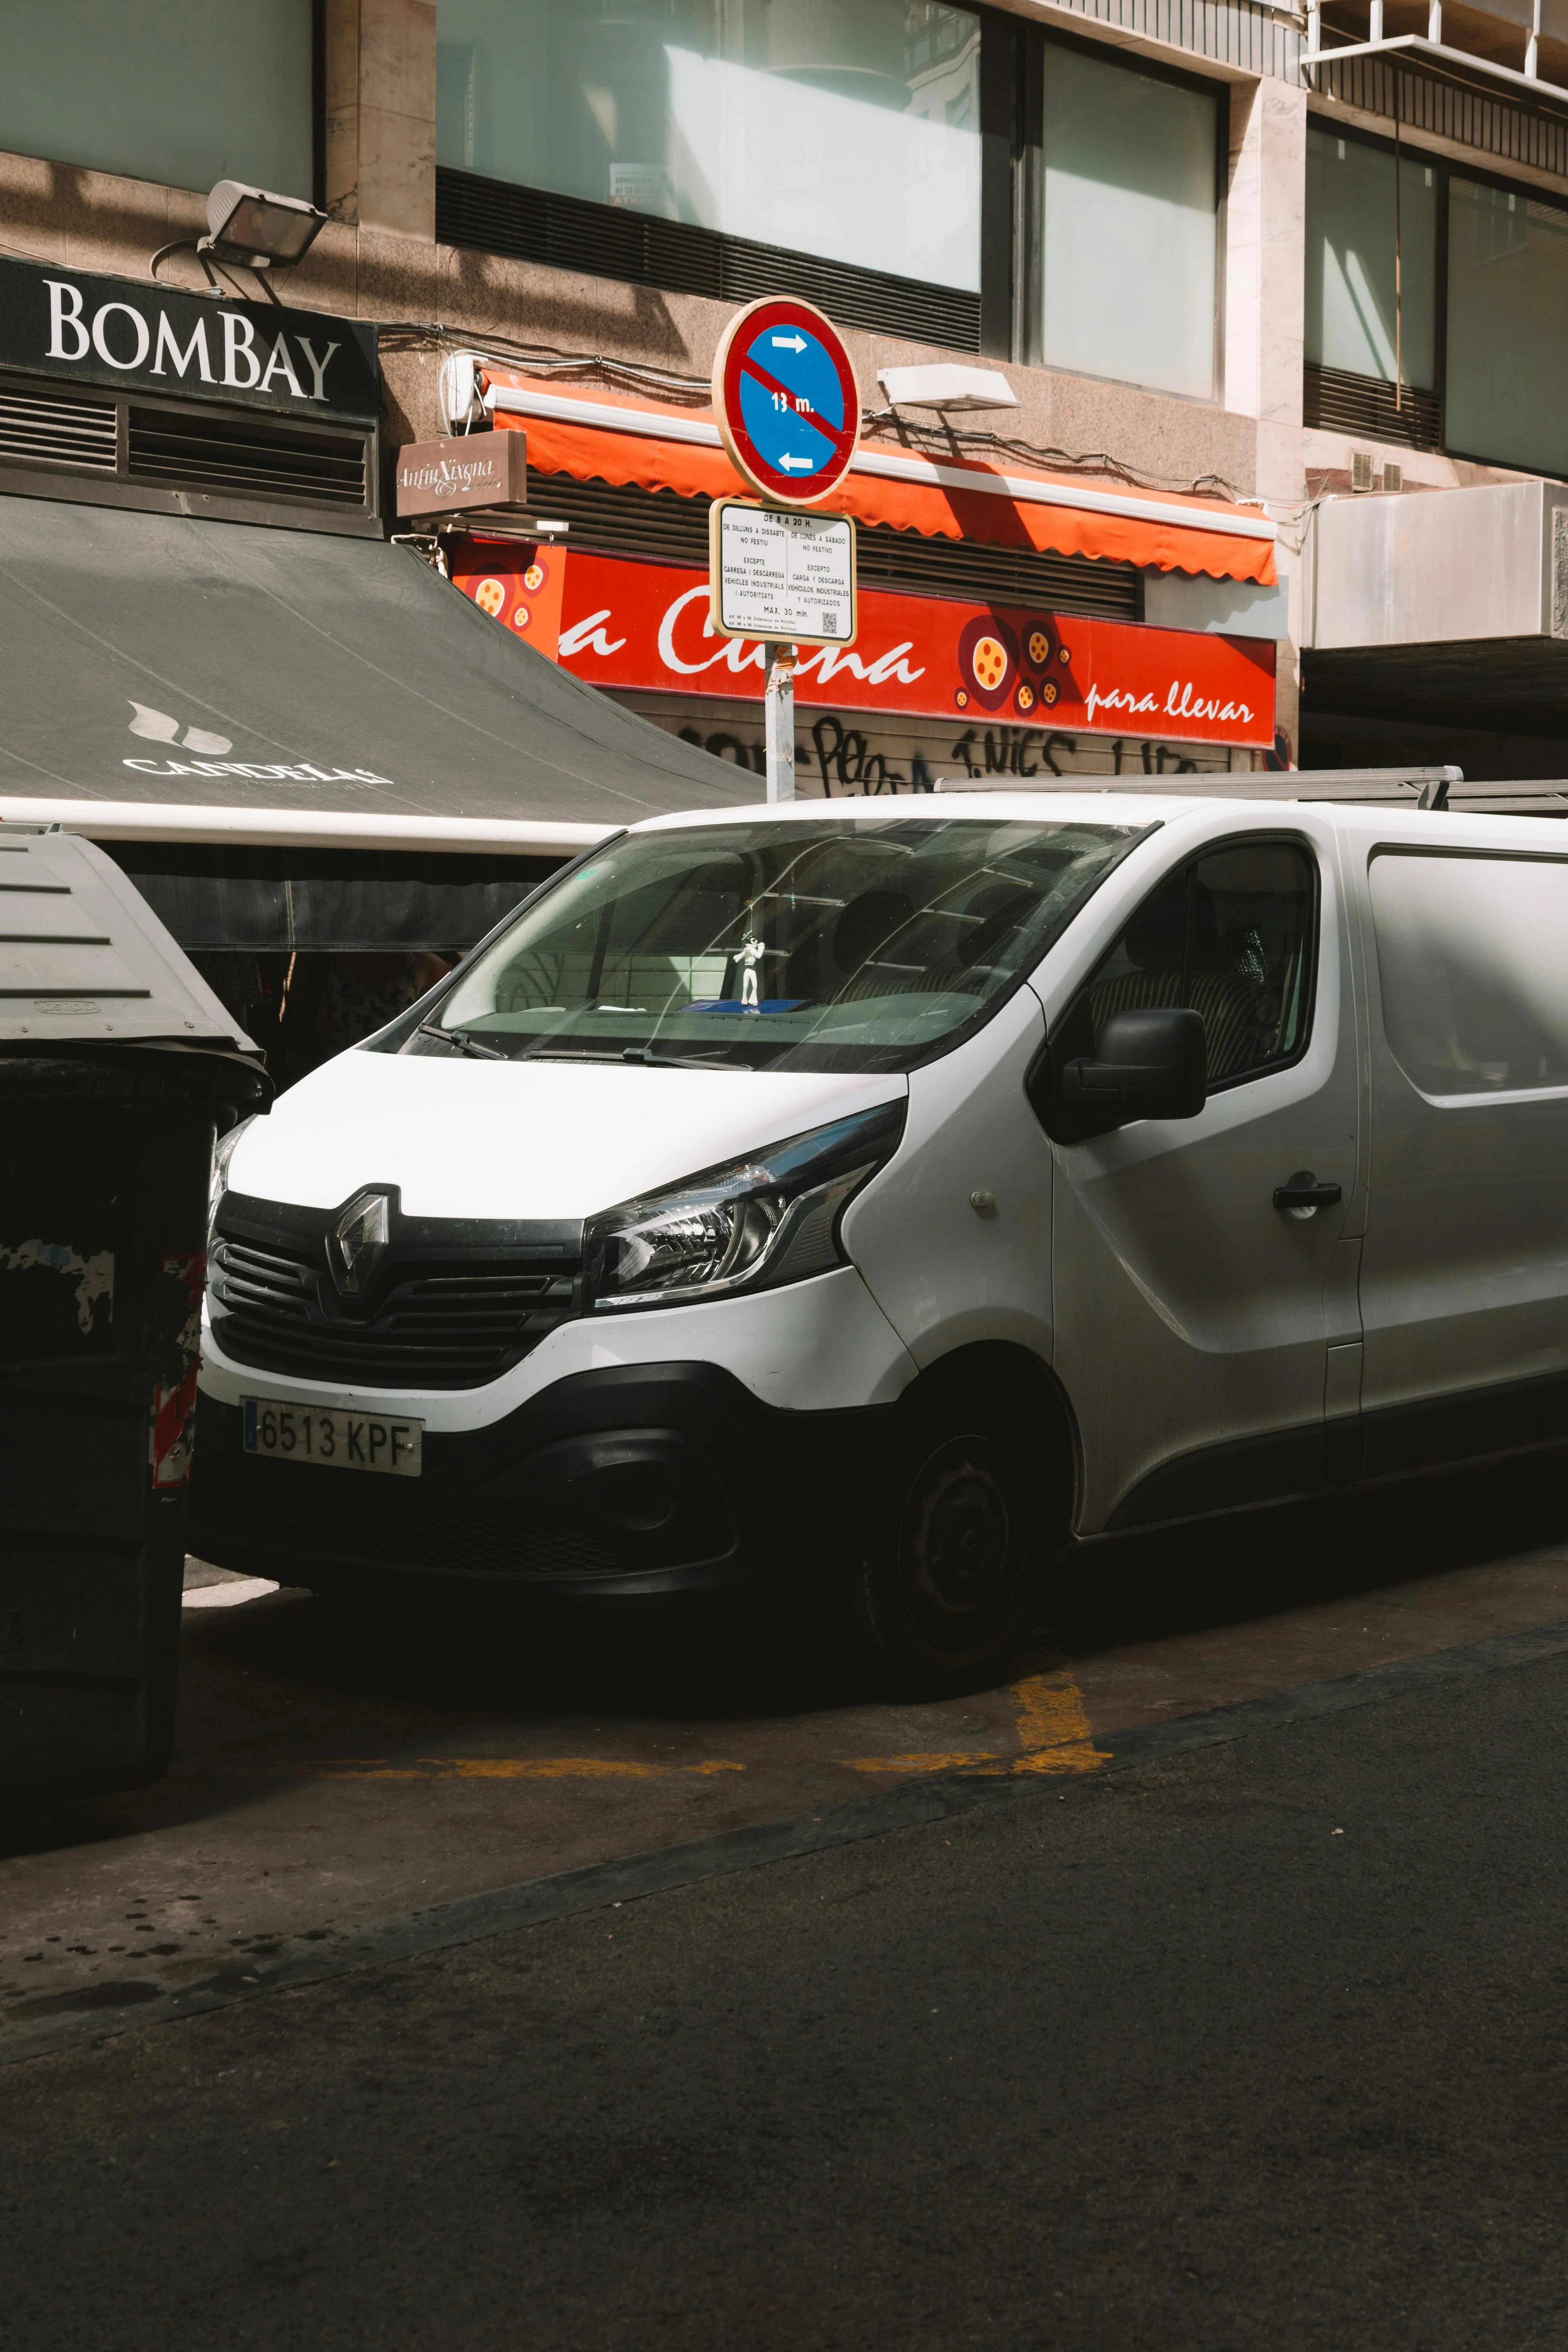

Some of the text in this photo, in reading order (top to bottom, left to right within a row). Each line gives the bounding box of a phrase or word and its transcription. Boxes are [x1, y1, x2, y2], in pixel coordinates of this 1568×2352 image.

[43, 280, 341, 401] BOMBAY
[772, 392, 814, 412] 13 m.
[805, 519, 812, 528] H.
[762, 528, 785, 537] DISSABTE
[825, 536, 845, 544] SÁBADO
[751, 580, 784, 590] INDUSTRIALS
[788, 584, 849, 597] VEHÍCULOS INDUSTRIALES
[740, 591, 773, 599] AUTORITZATS
[804, 597, 840, 606] AUTORIZADOS
[764, 606, 780, 614] MAX.
[658, 585, 925, 684] Cuna
[1084, 681, 1254, 723] para llevar
[122, 759, 394, 784] CANDELAS
[262, 1410, 409, 1465] 6513 KPF
